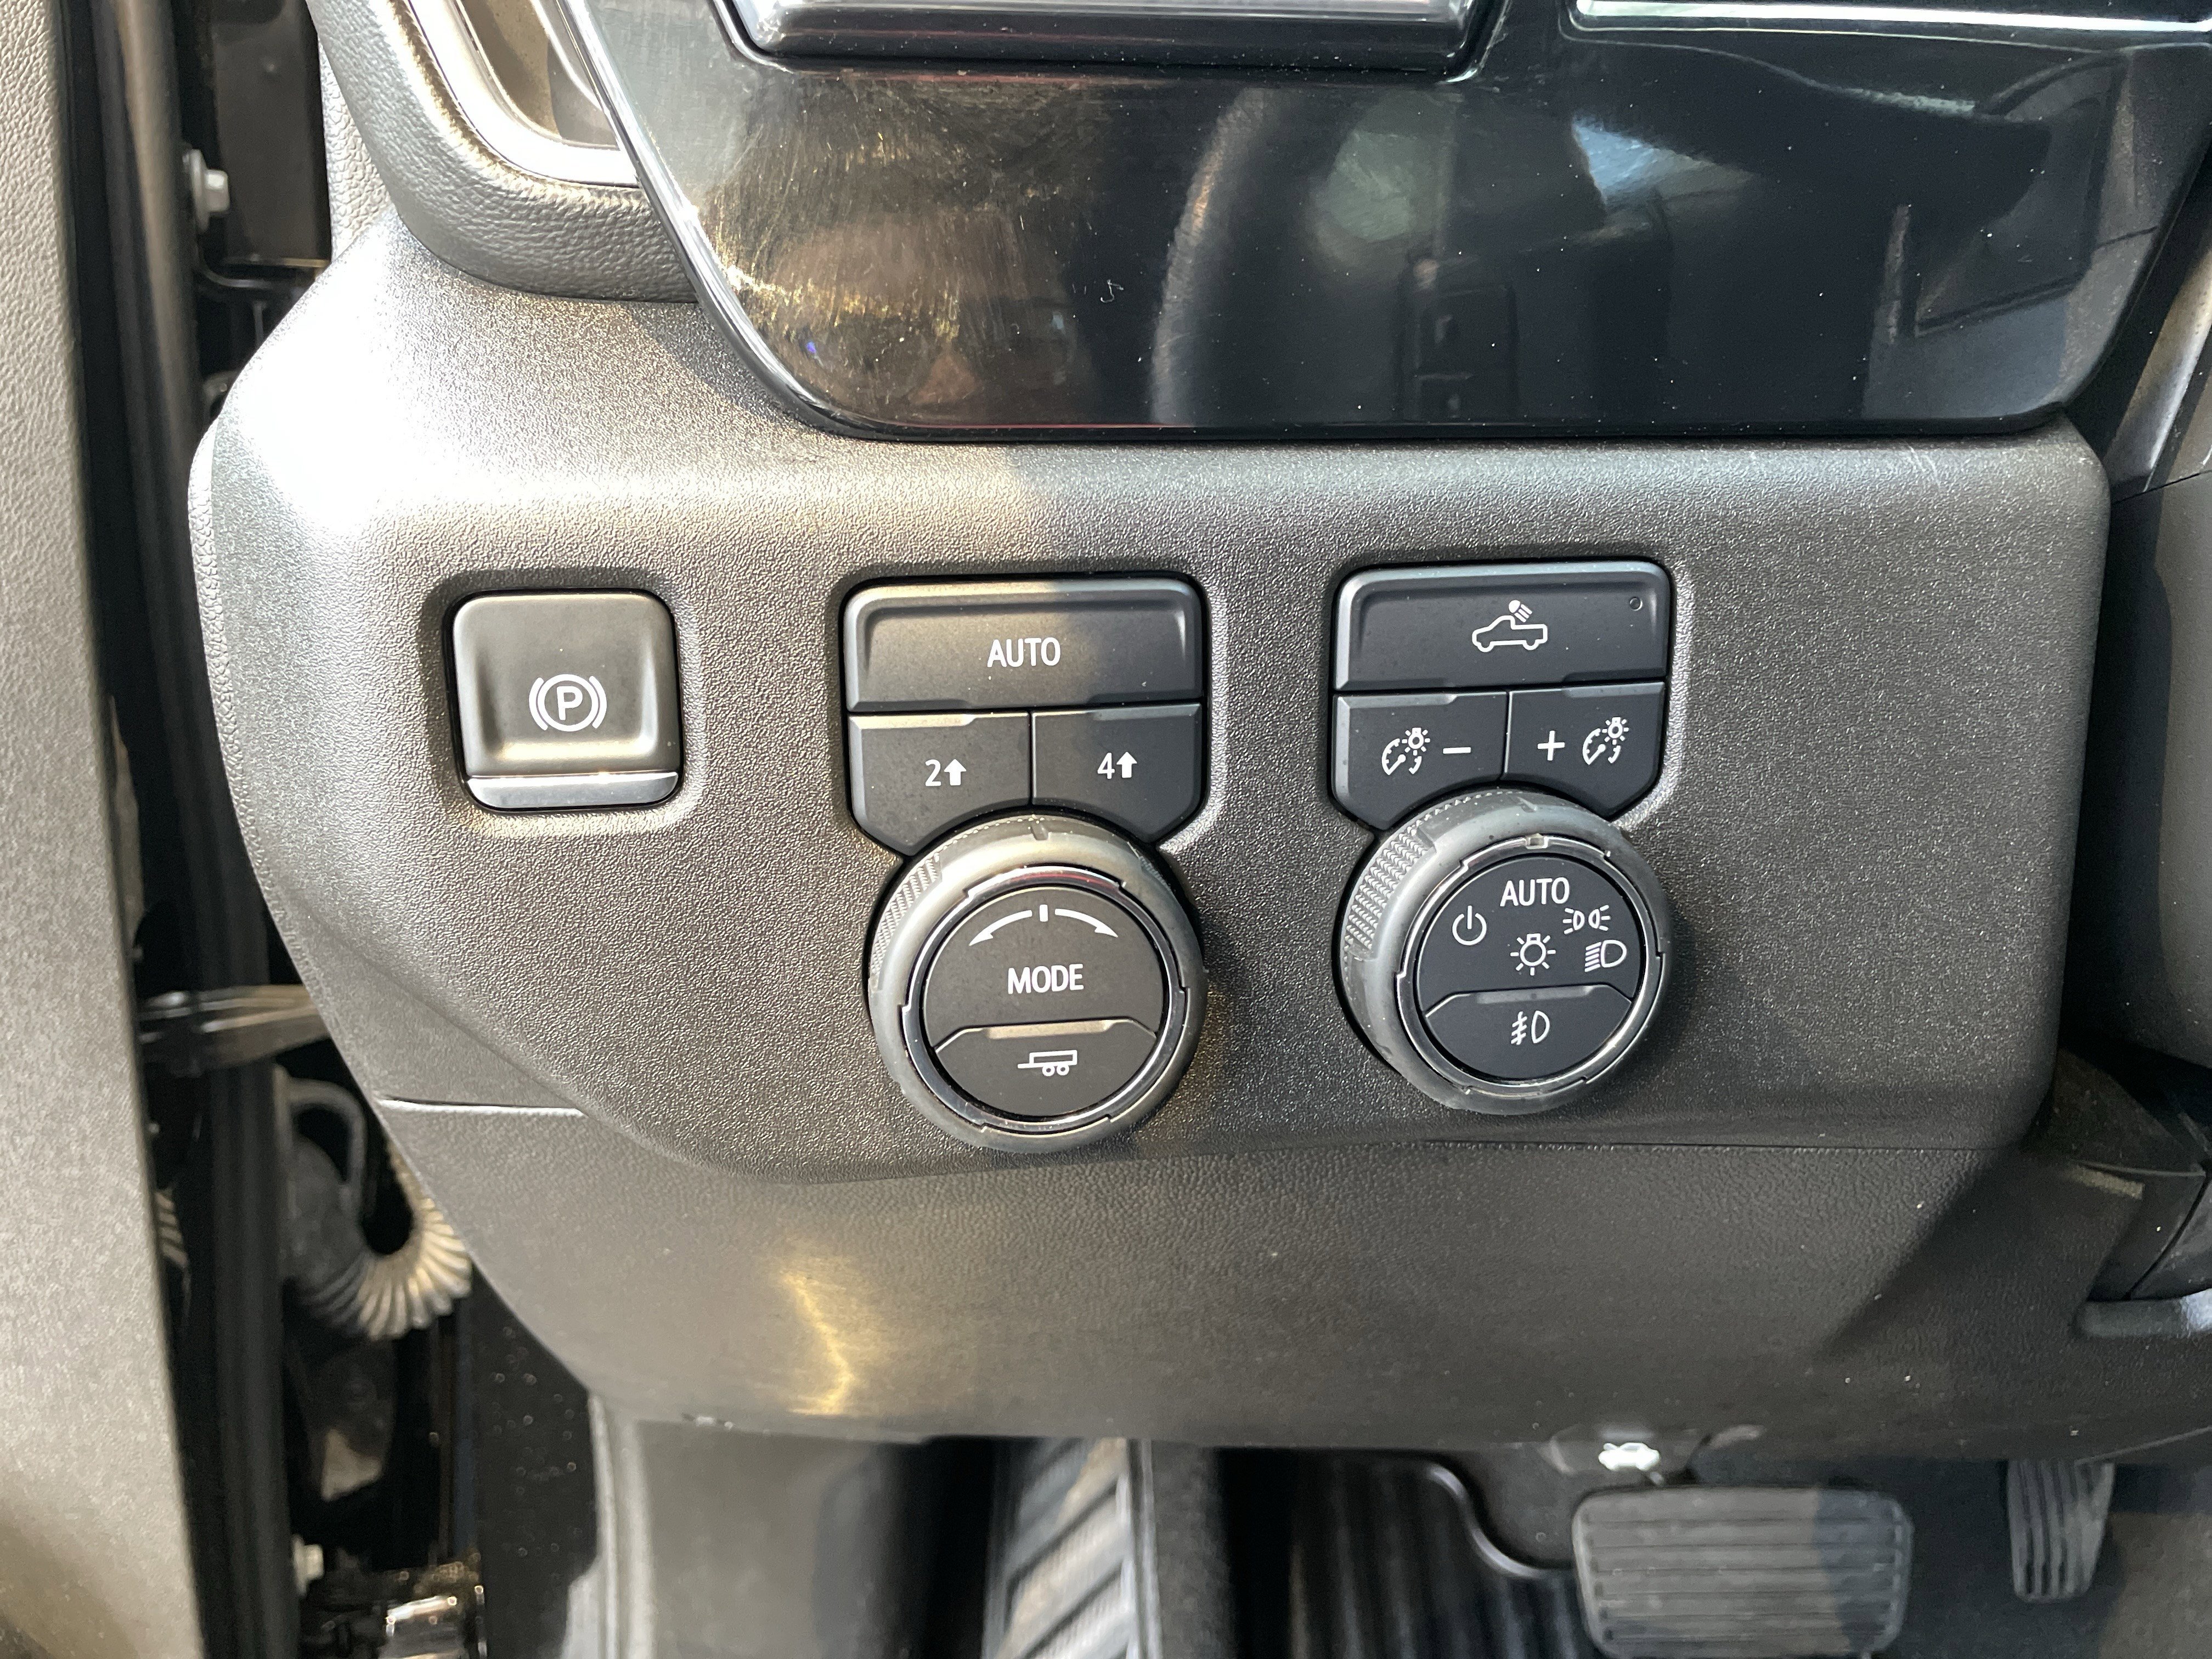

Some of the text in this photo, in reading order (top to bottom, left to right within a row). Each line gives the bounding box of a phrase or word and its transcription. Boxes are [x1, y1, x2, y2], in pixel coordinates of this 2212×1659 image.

[987, 636, 1061, 668] AUTO
[556, 685, 583, 721] P
[1499, 877, 1570, 907] AUTO
[1007, 963, 1084, 995] MODE
